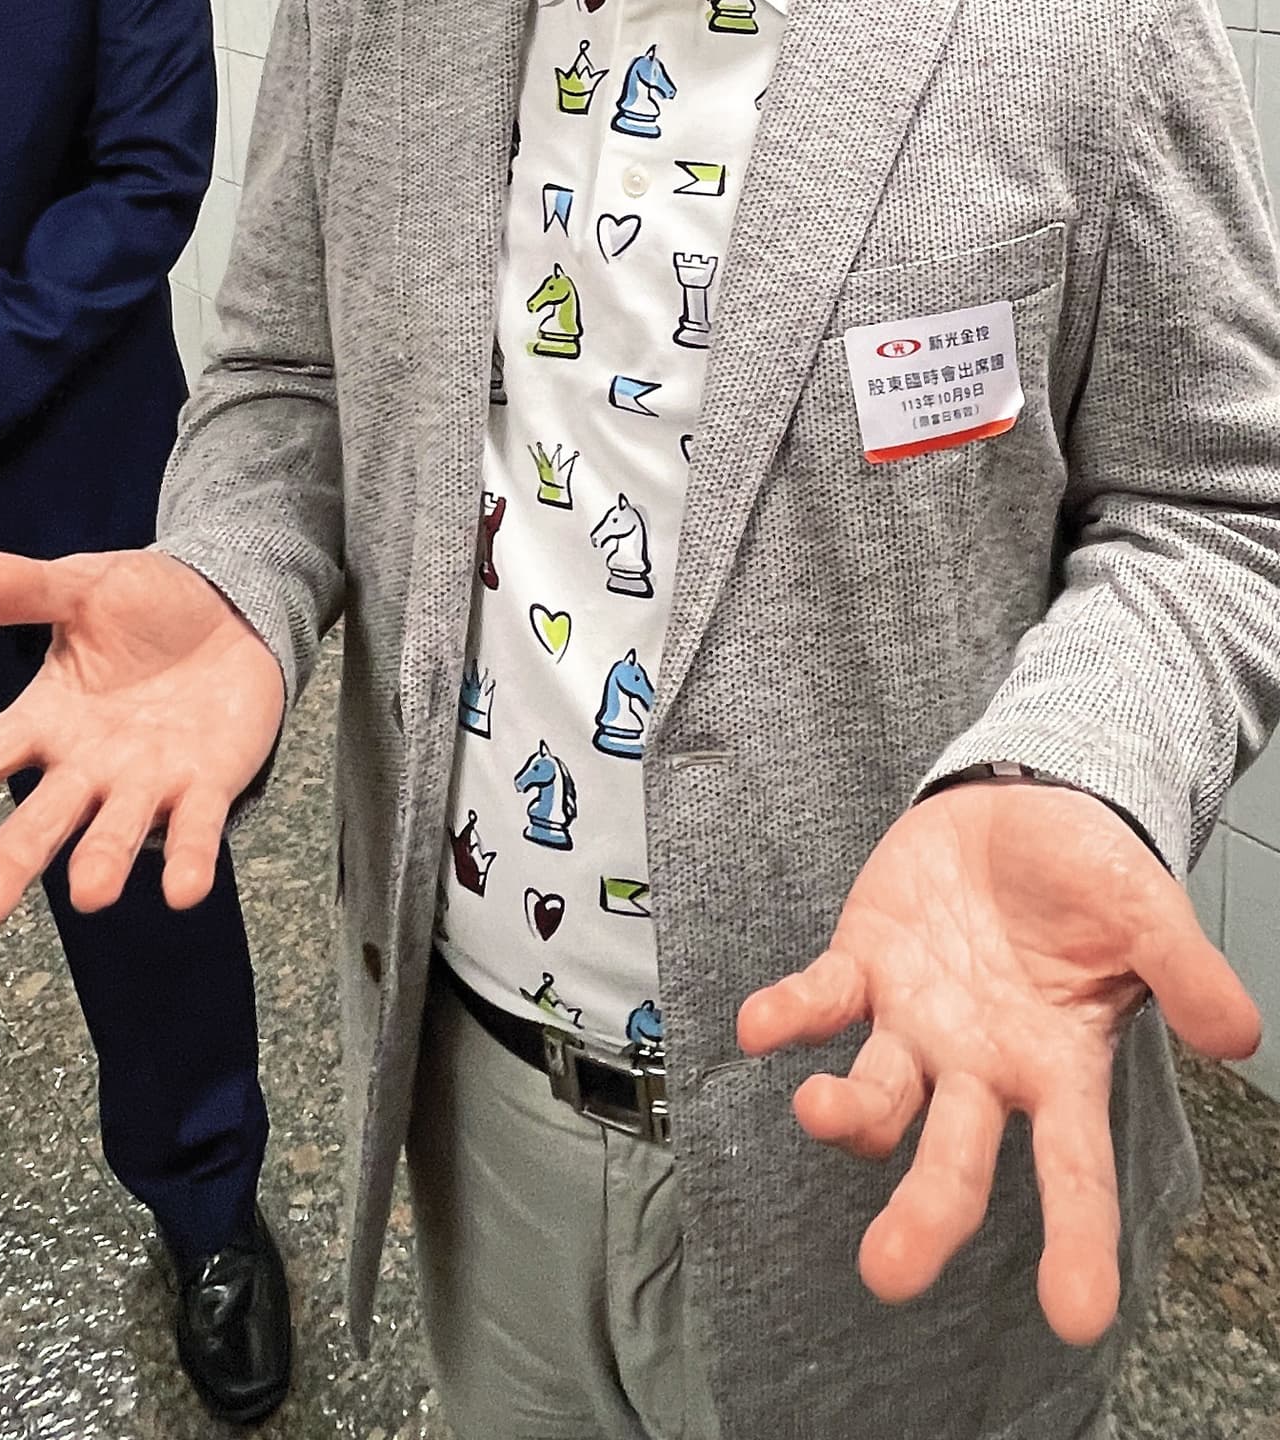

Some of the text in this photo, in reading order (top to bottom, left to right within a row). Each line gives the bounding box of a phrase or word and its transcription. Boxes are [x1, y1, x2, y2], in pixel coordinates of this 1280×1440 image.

[928, 325, 990, 352] 新光金控
[901, 382, 985, 412] 113年10月9日
